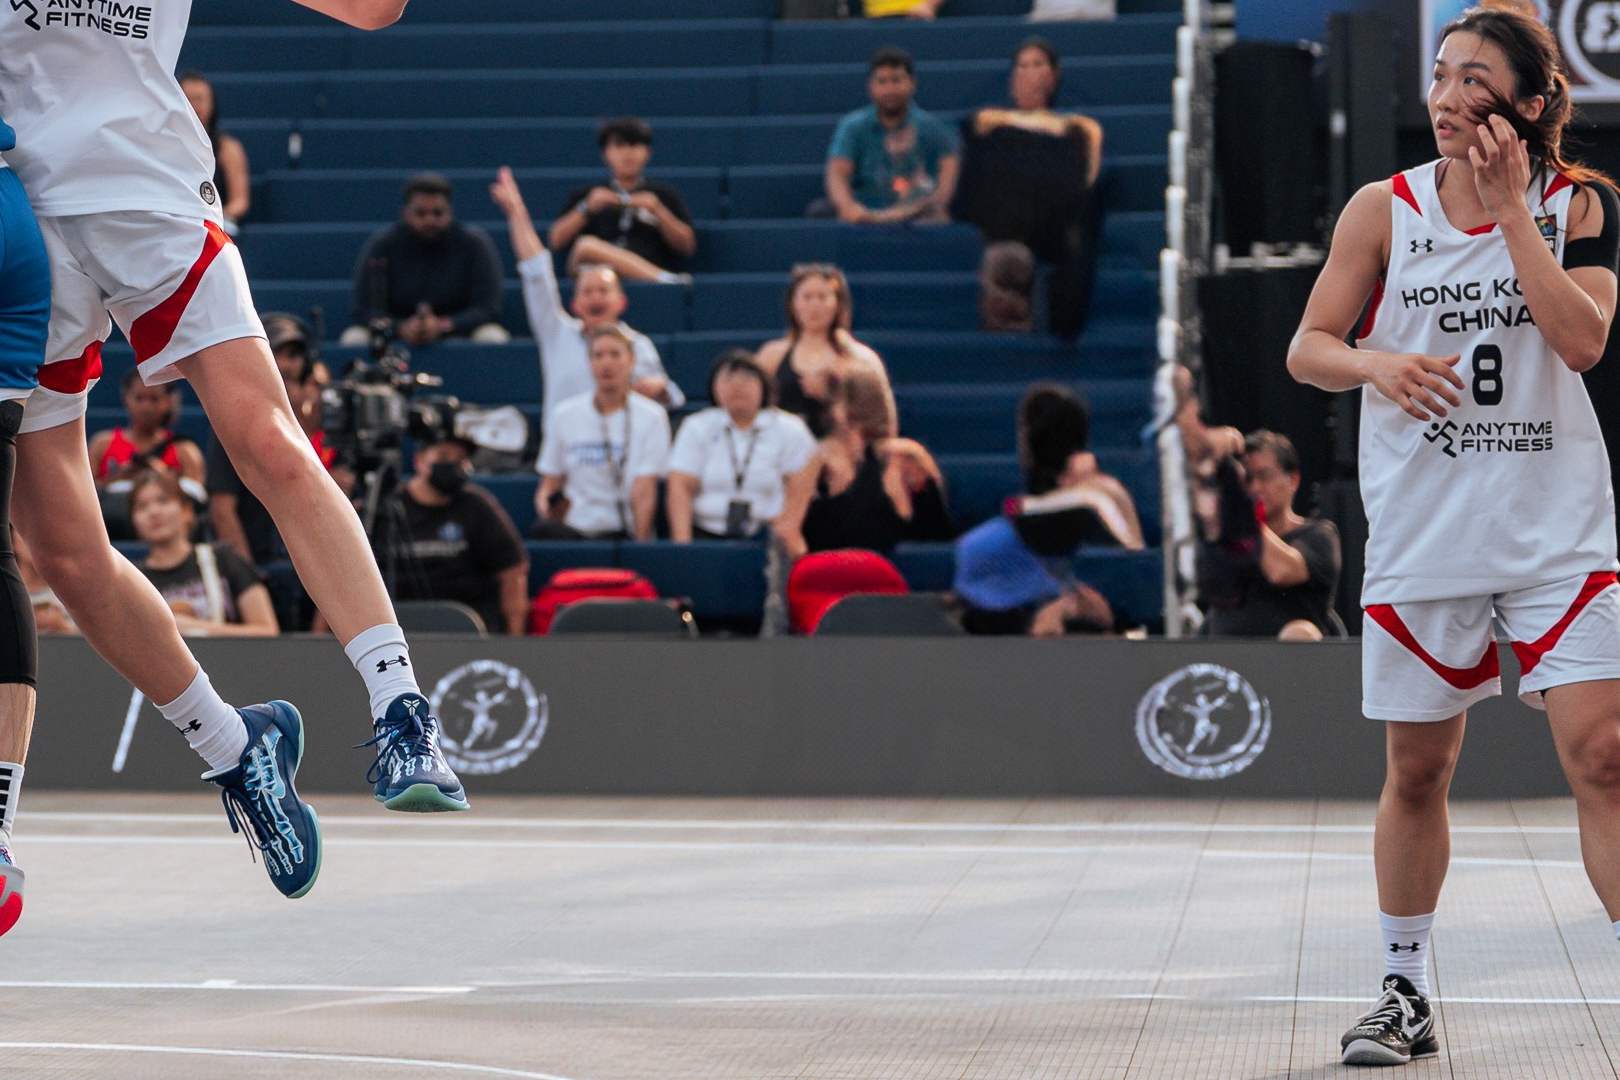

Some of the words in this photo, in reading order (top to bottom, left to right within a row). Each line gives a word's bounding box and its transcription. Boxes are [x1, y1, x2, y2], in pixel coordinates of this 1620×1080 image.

[45, 11, 149, 40] FITNESS
[1401, 282, 1481, 309] HONG
[1438, 304, 1536, 333] CHINA
[1472, 344, 1504, 406] 8
[1461, 420, 1553, 437] ANYTIME
[1461, 436, 1554, 453] FITNESS
